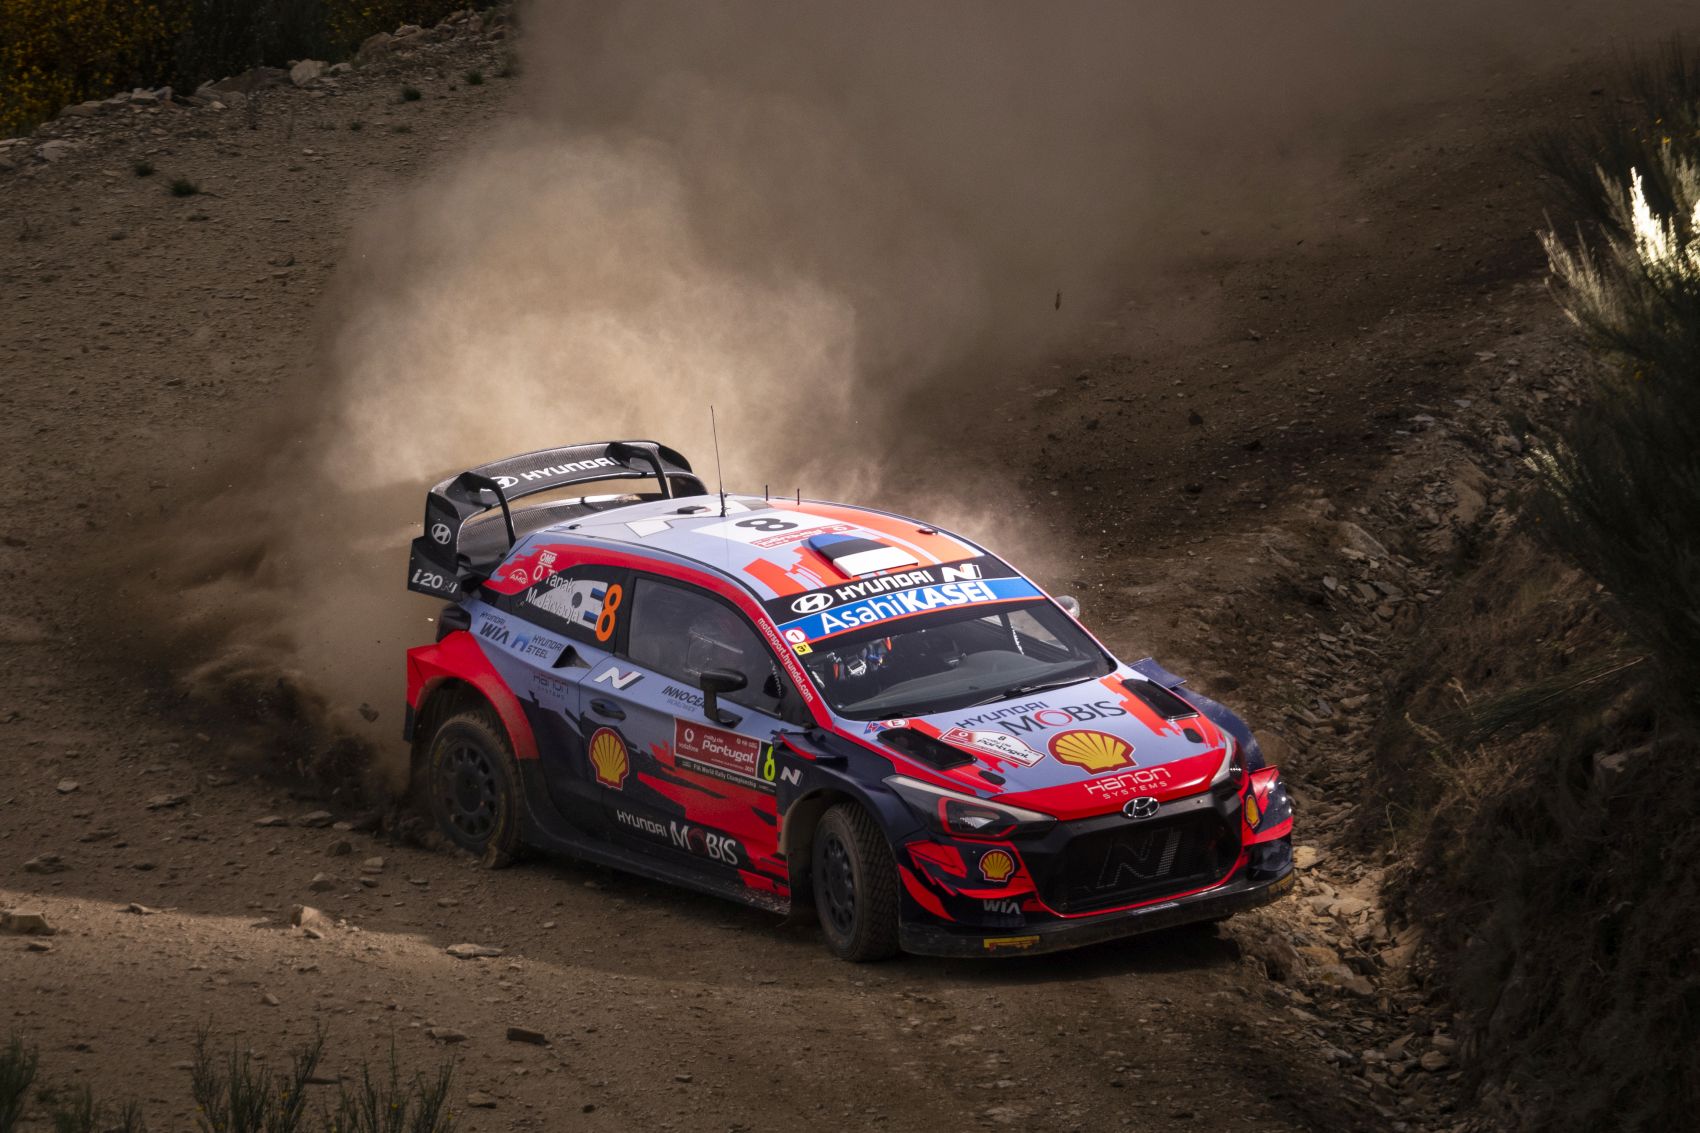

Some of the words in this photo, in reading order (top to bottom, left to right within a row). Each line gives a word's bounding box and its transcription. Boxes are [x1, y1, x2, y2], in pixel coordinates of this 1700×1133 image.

[735, 517, 799, 531] 8
[835, 569, 934, 601] HYUNDAI
[595, 584, 623, 642] 8
[525, 644, 548, 658] STEEL
[532, 633, 564, 652] HYUNDAI
[757, 618, 814, 703] motorsport.hyundai.com
[593, 666, 645, 691] N
[662, 685, 705, 709] INNOCEA
[956, 701, 1049, 728] HYUNDAI
[997, 699, 1128, 738] MOBIS
[702, 739, 754, 764] Portugal
[763, 745, 776, 782] 6
[1101, 780, 1168, 800] SYSTEMS
[616, 809, 668, 837] HYUNDAI
[670, 820, 739, 865] MOBIS
